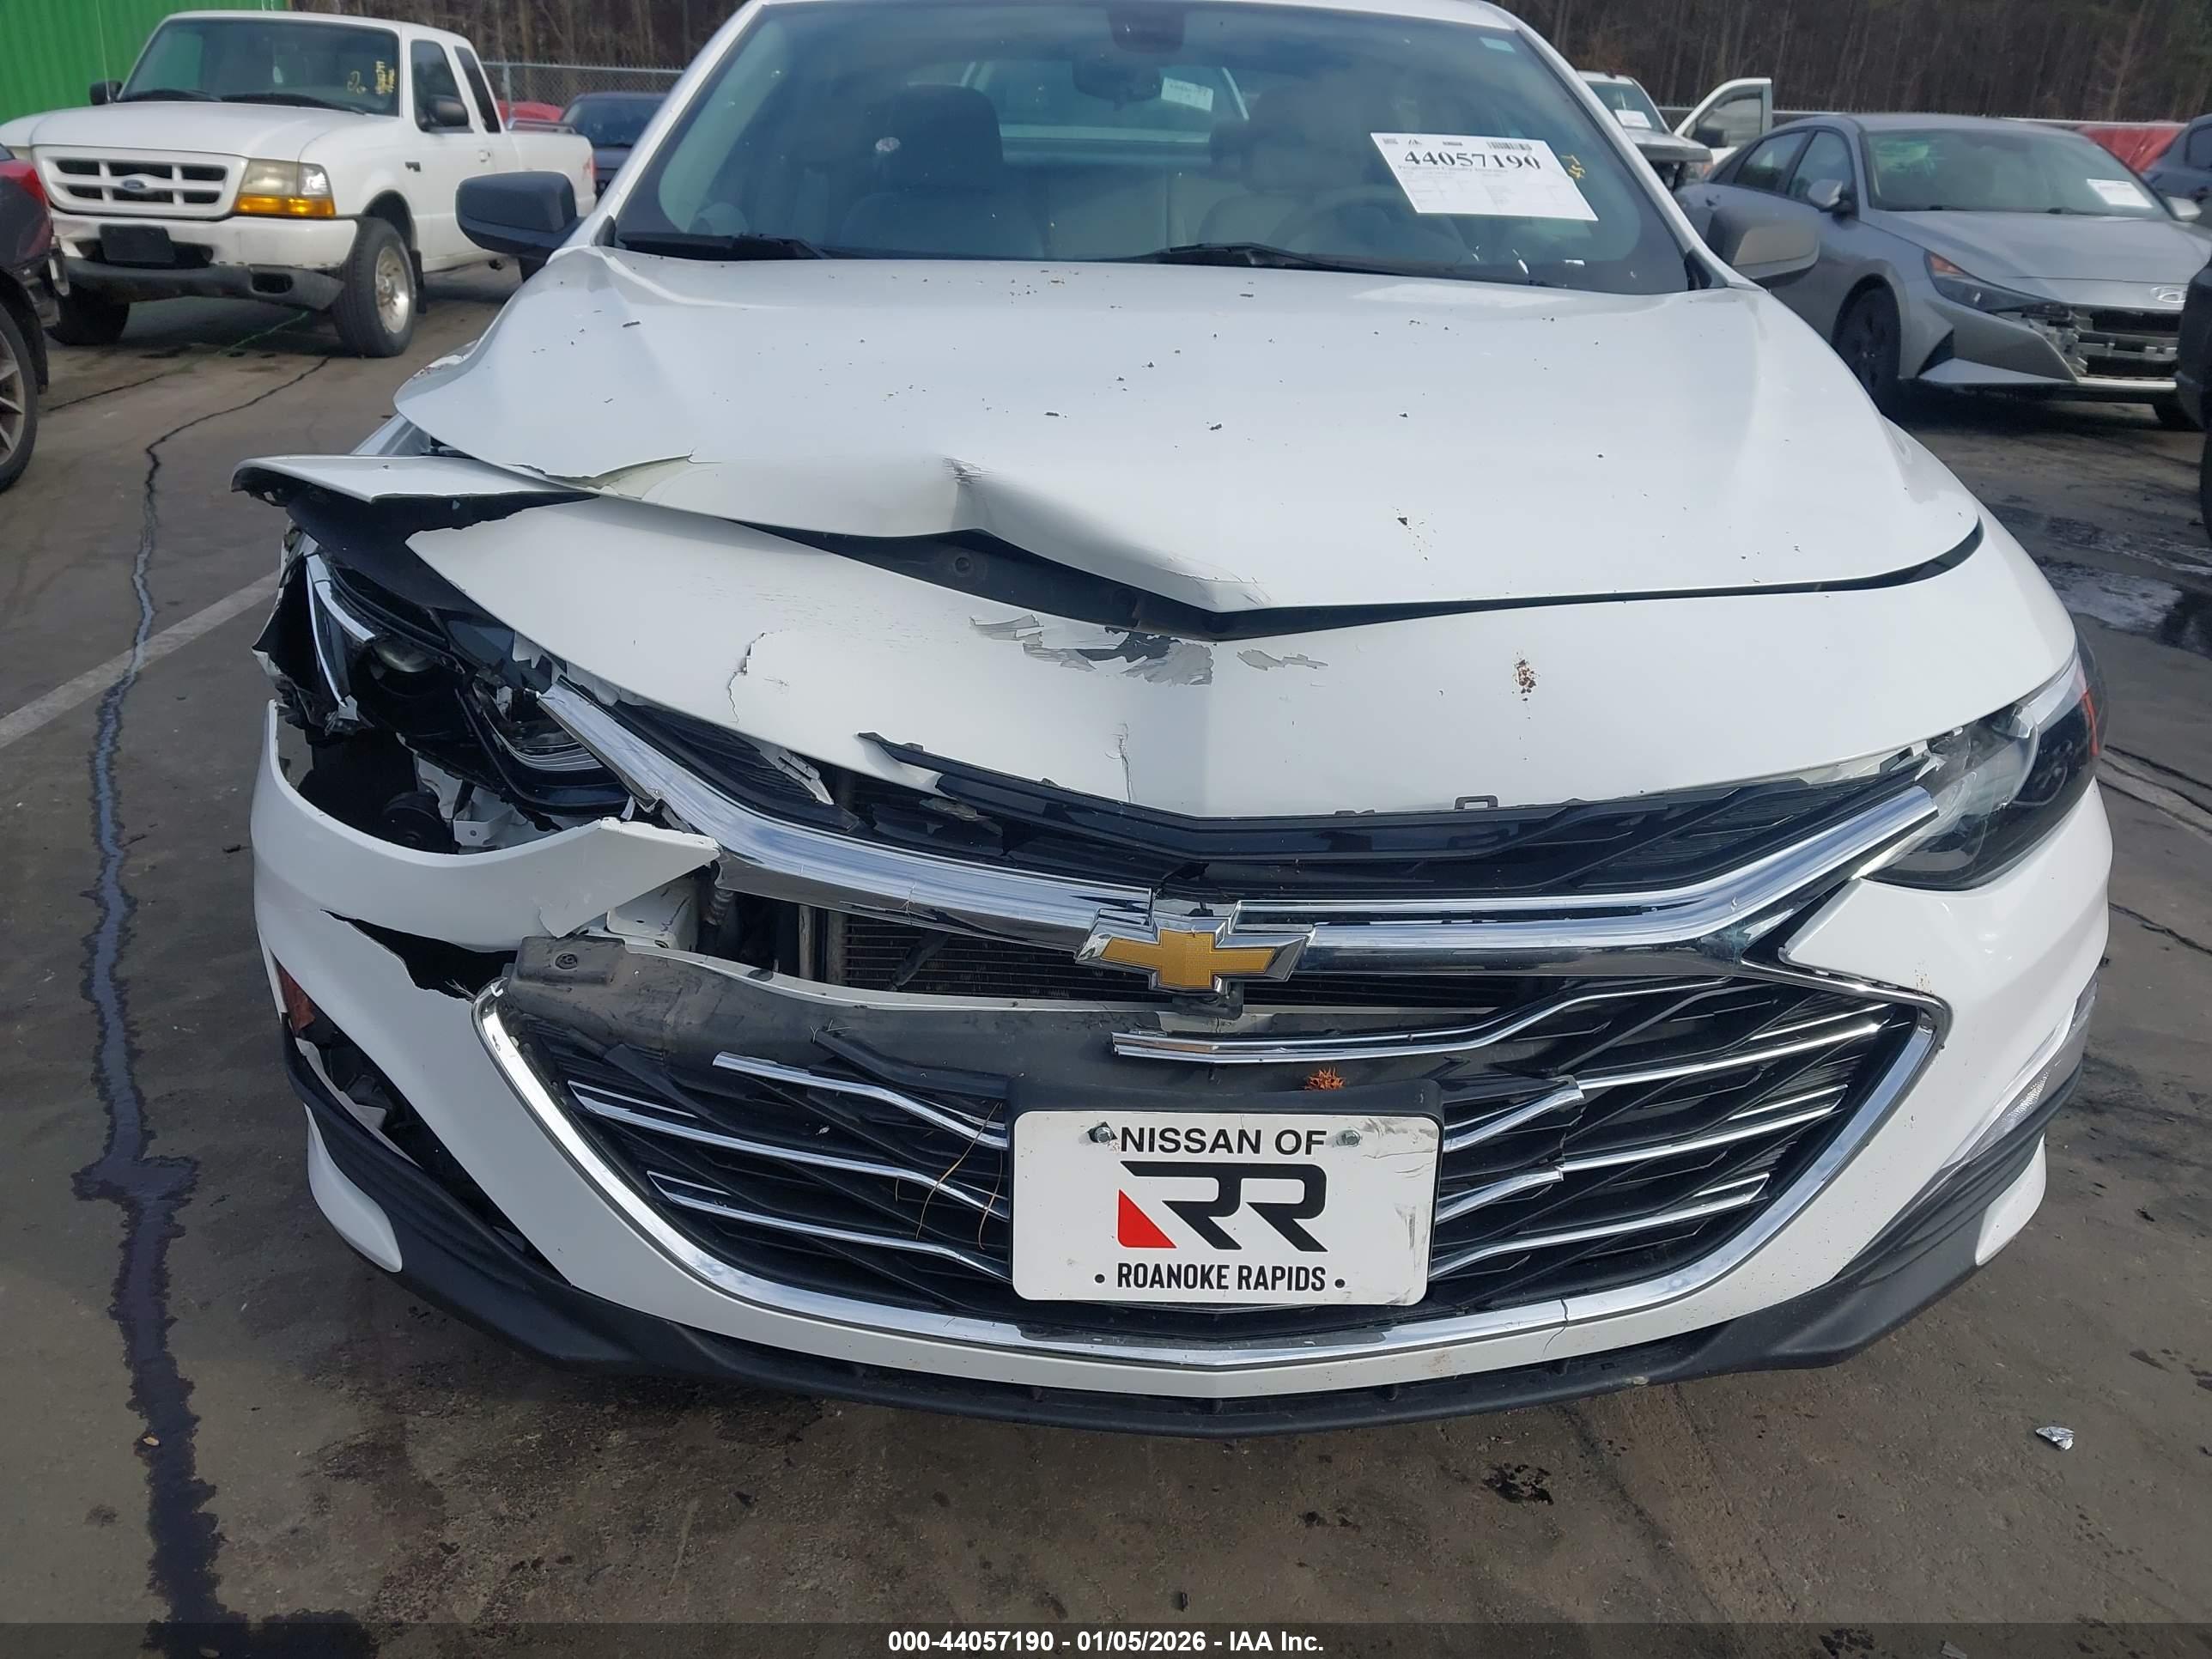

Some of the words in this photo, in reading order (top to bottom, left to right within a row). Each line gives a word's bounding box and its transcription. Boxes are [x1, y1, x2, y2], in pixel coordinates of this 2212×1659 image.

[1405, 150, 1540, 169] 44057190
[1121, 1127, 1261, 1154] NISSAN
[1274, 1128, 1328, 1156] OF
[1116, 1262, 1231, 1290] ROANOKE
[1237, 1264, 1326, 1291] RAPIDS
